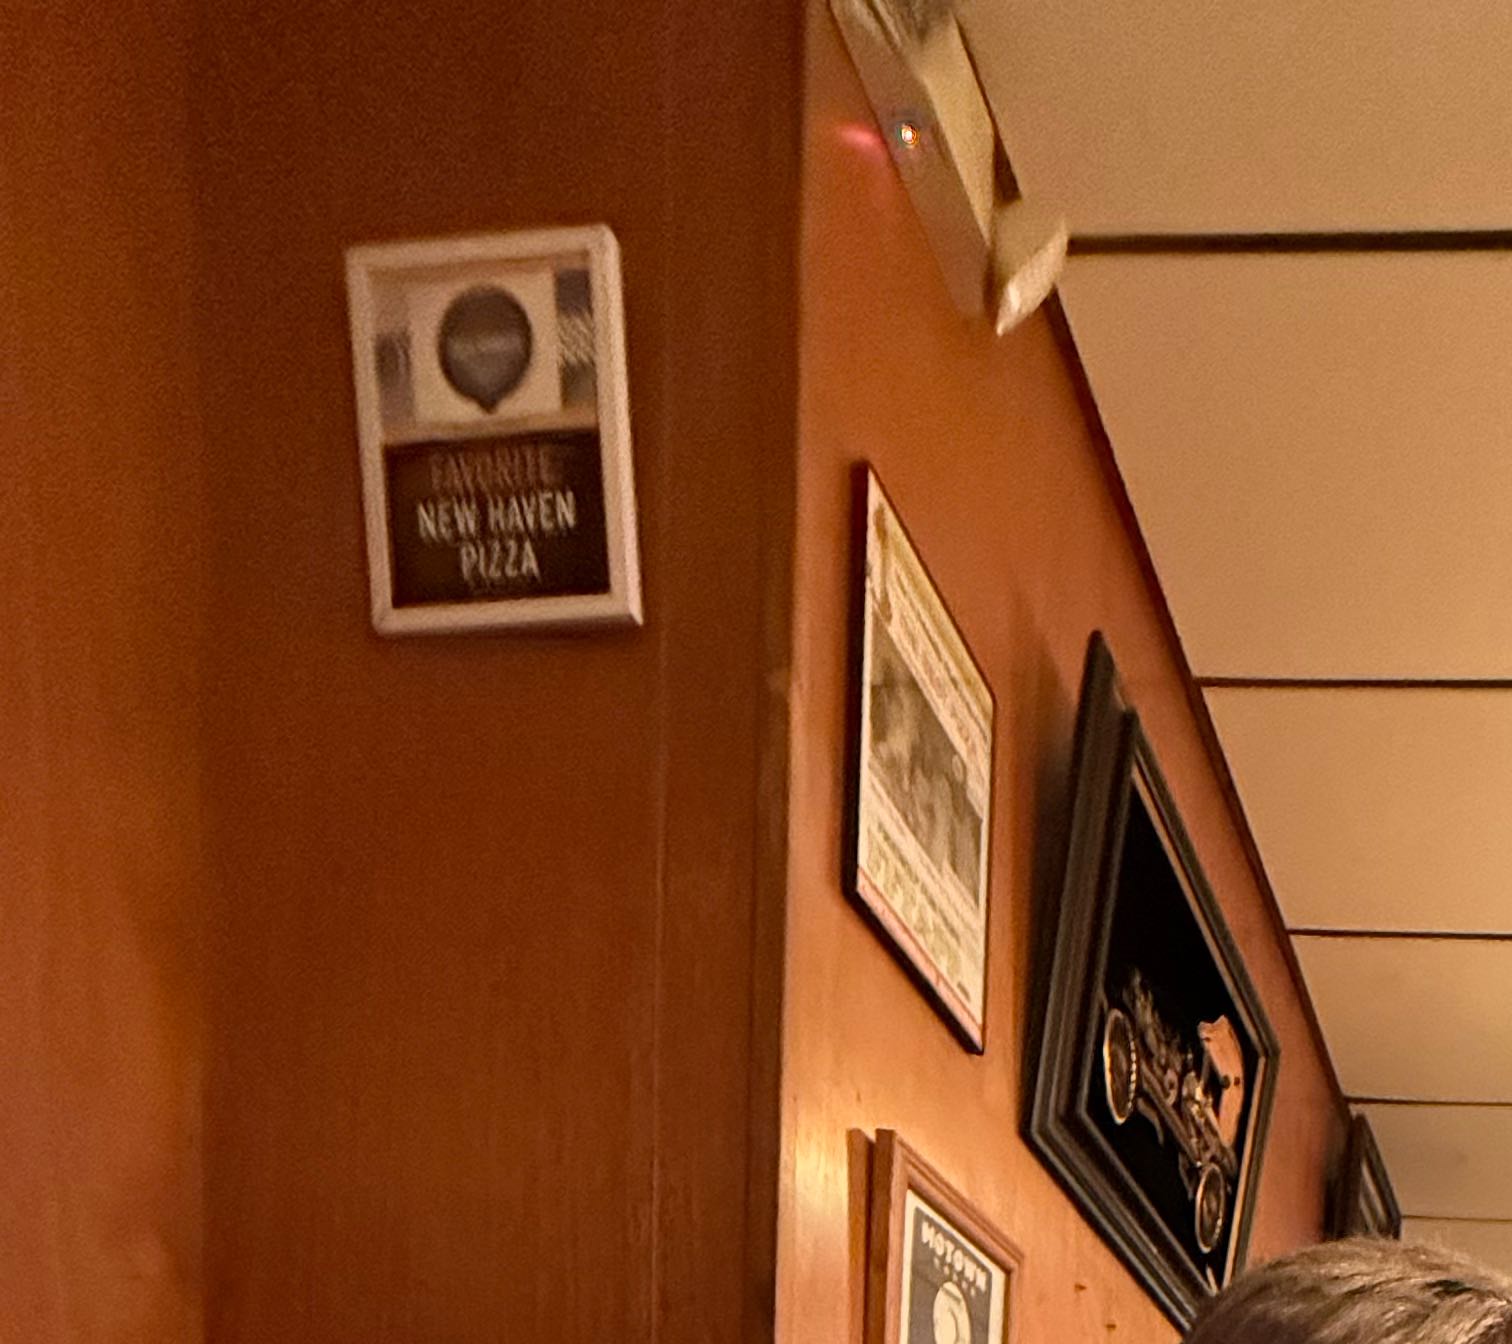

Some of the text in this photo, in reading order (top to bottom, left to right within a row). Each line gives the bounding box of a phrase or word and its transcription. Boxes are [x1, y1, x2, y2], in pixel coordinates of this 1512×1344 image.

[417, 488, 577, 543] NEW HAVEN
[460, 538, 542, 583] PIZZA
[921, 1220, 987, 1293] MOTOWN
